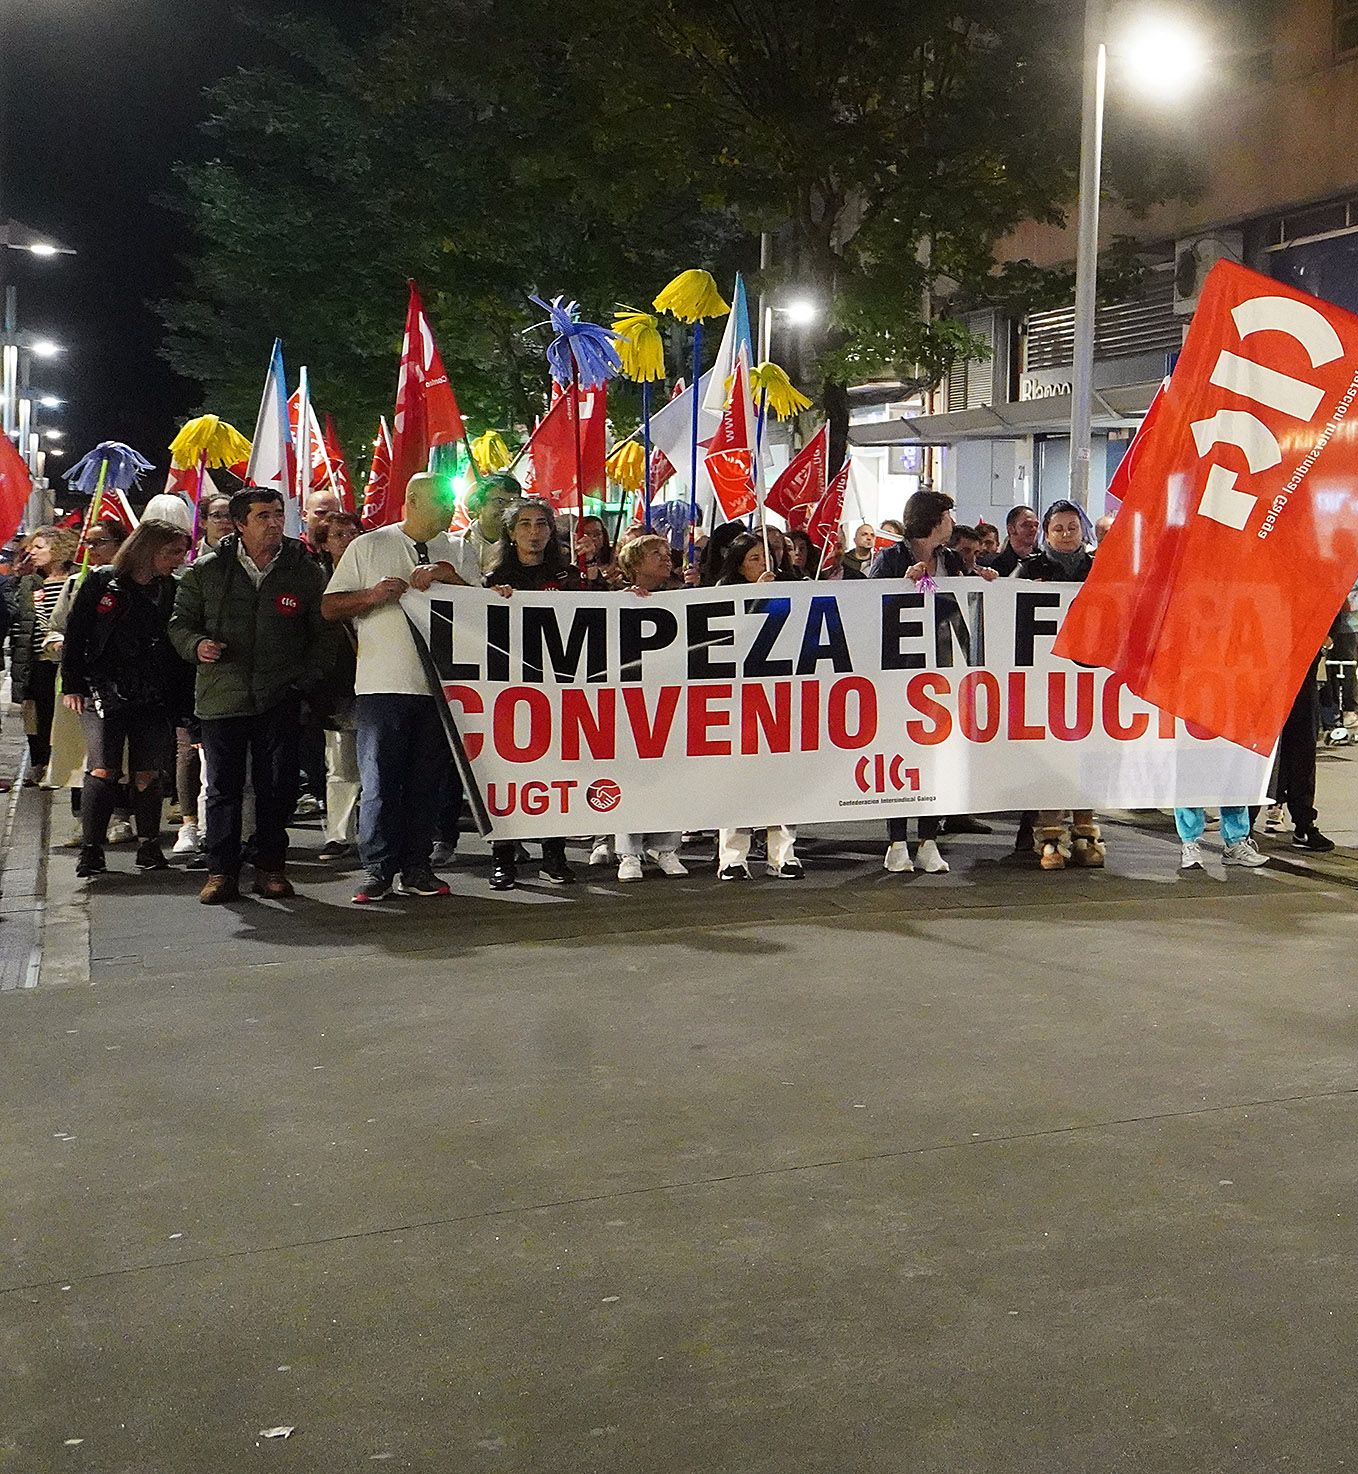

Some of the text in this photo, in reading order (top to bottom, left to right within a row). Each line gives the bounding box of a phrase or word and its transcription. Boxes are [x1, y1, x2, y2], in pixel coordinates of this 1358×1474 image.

[430, 596, 854, 683] LIMPEZA
[881, 591, 985, 671] EN
[442, 676, 878, 764] CONVENIO
[487, 781, 578, 817] UGT
[854, 753, 920, 794] CIG
